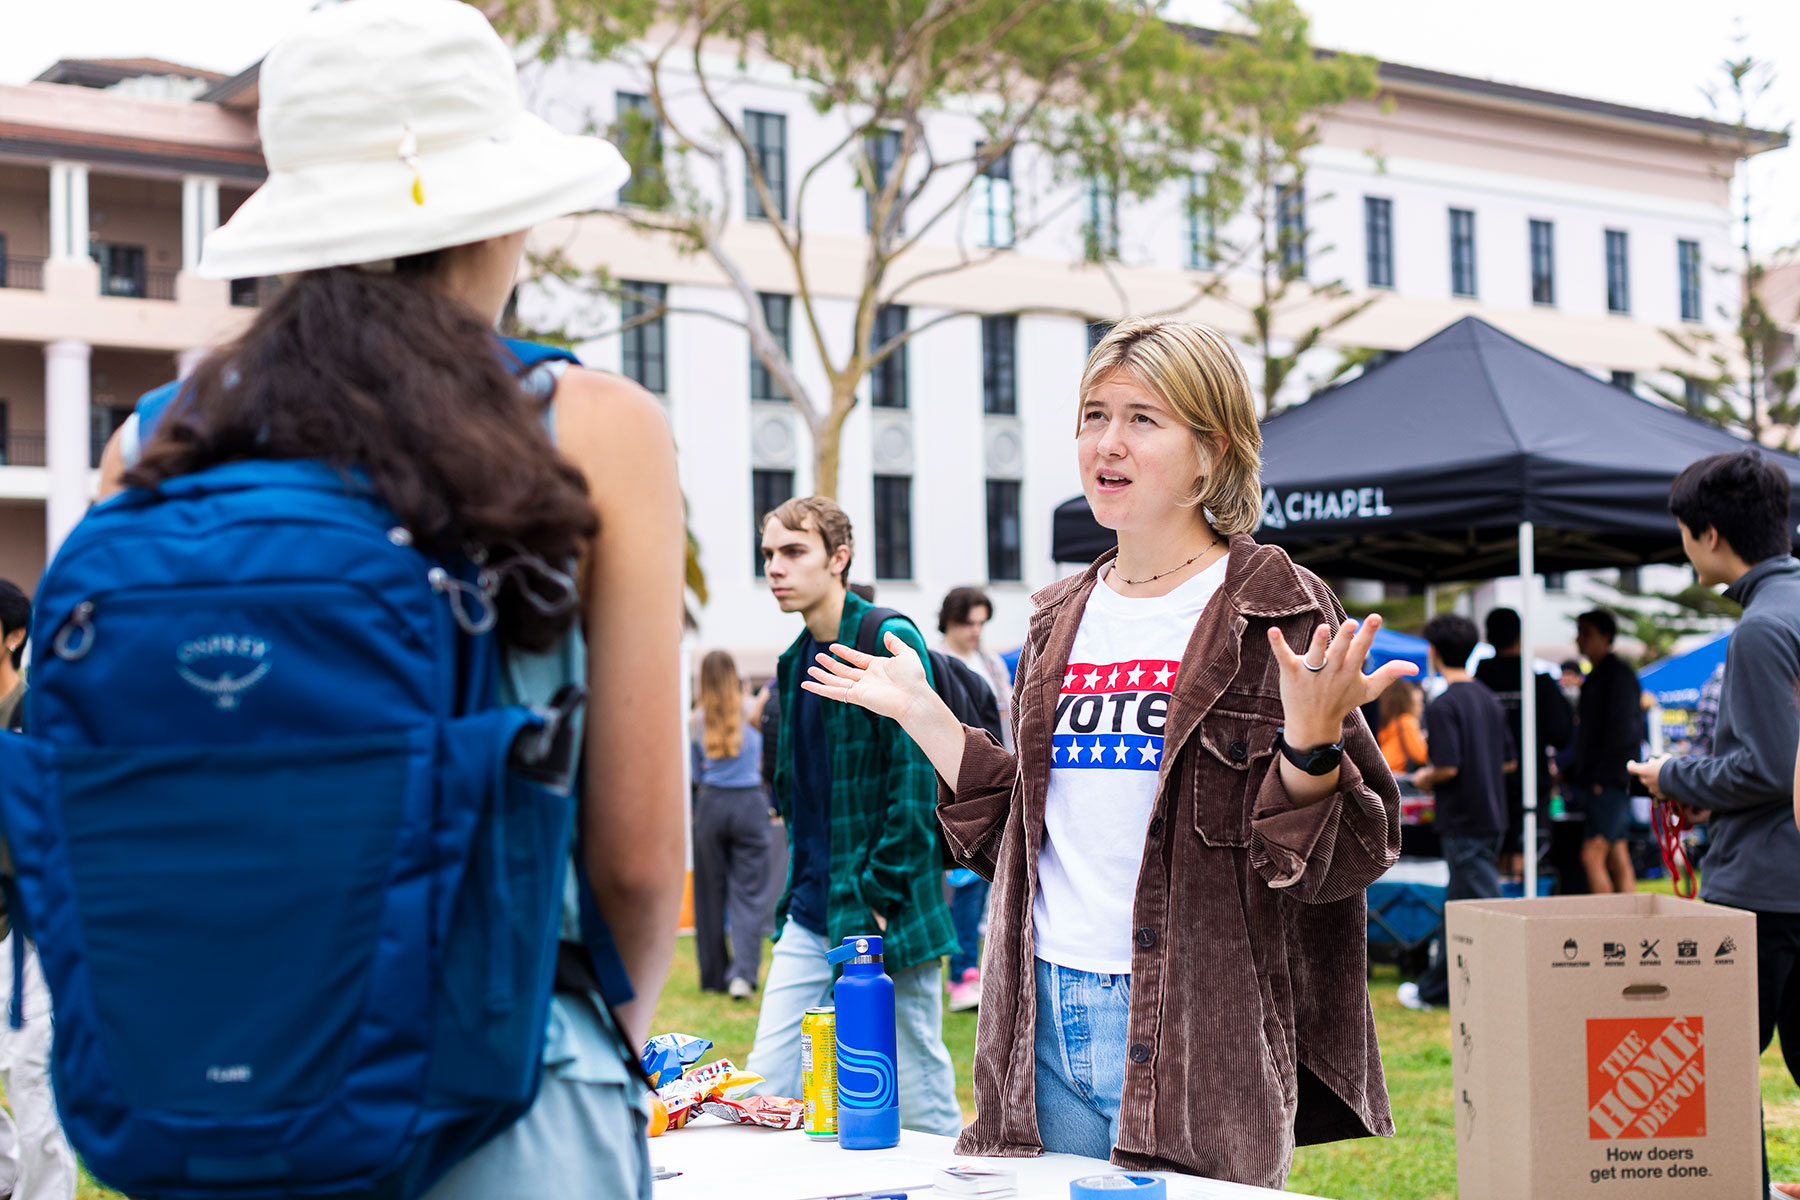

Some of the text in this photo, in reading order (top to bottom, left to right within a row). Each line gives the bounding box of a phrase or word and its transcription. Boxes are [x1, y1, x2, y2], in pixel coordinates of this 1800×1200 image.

[1285, 487, 1392, 521] CHAPEL
[177, 633, 272, 664] OSPREY
[1598, 1029, 1647, 1079] THE
[1589, 1016, 1705, 1140] HOME
[1634, 1060, 1705, 1138] DEPOT
[1607, 1146, 1694, 1162] How doers
[1590, 1164, 1713, 1183] get more done.
